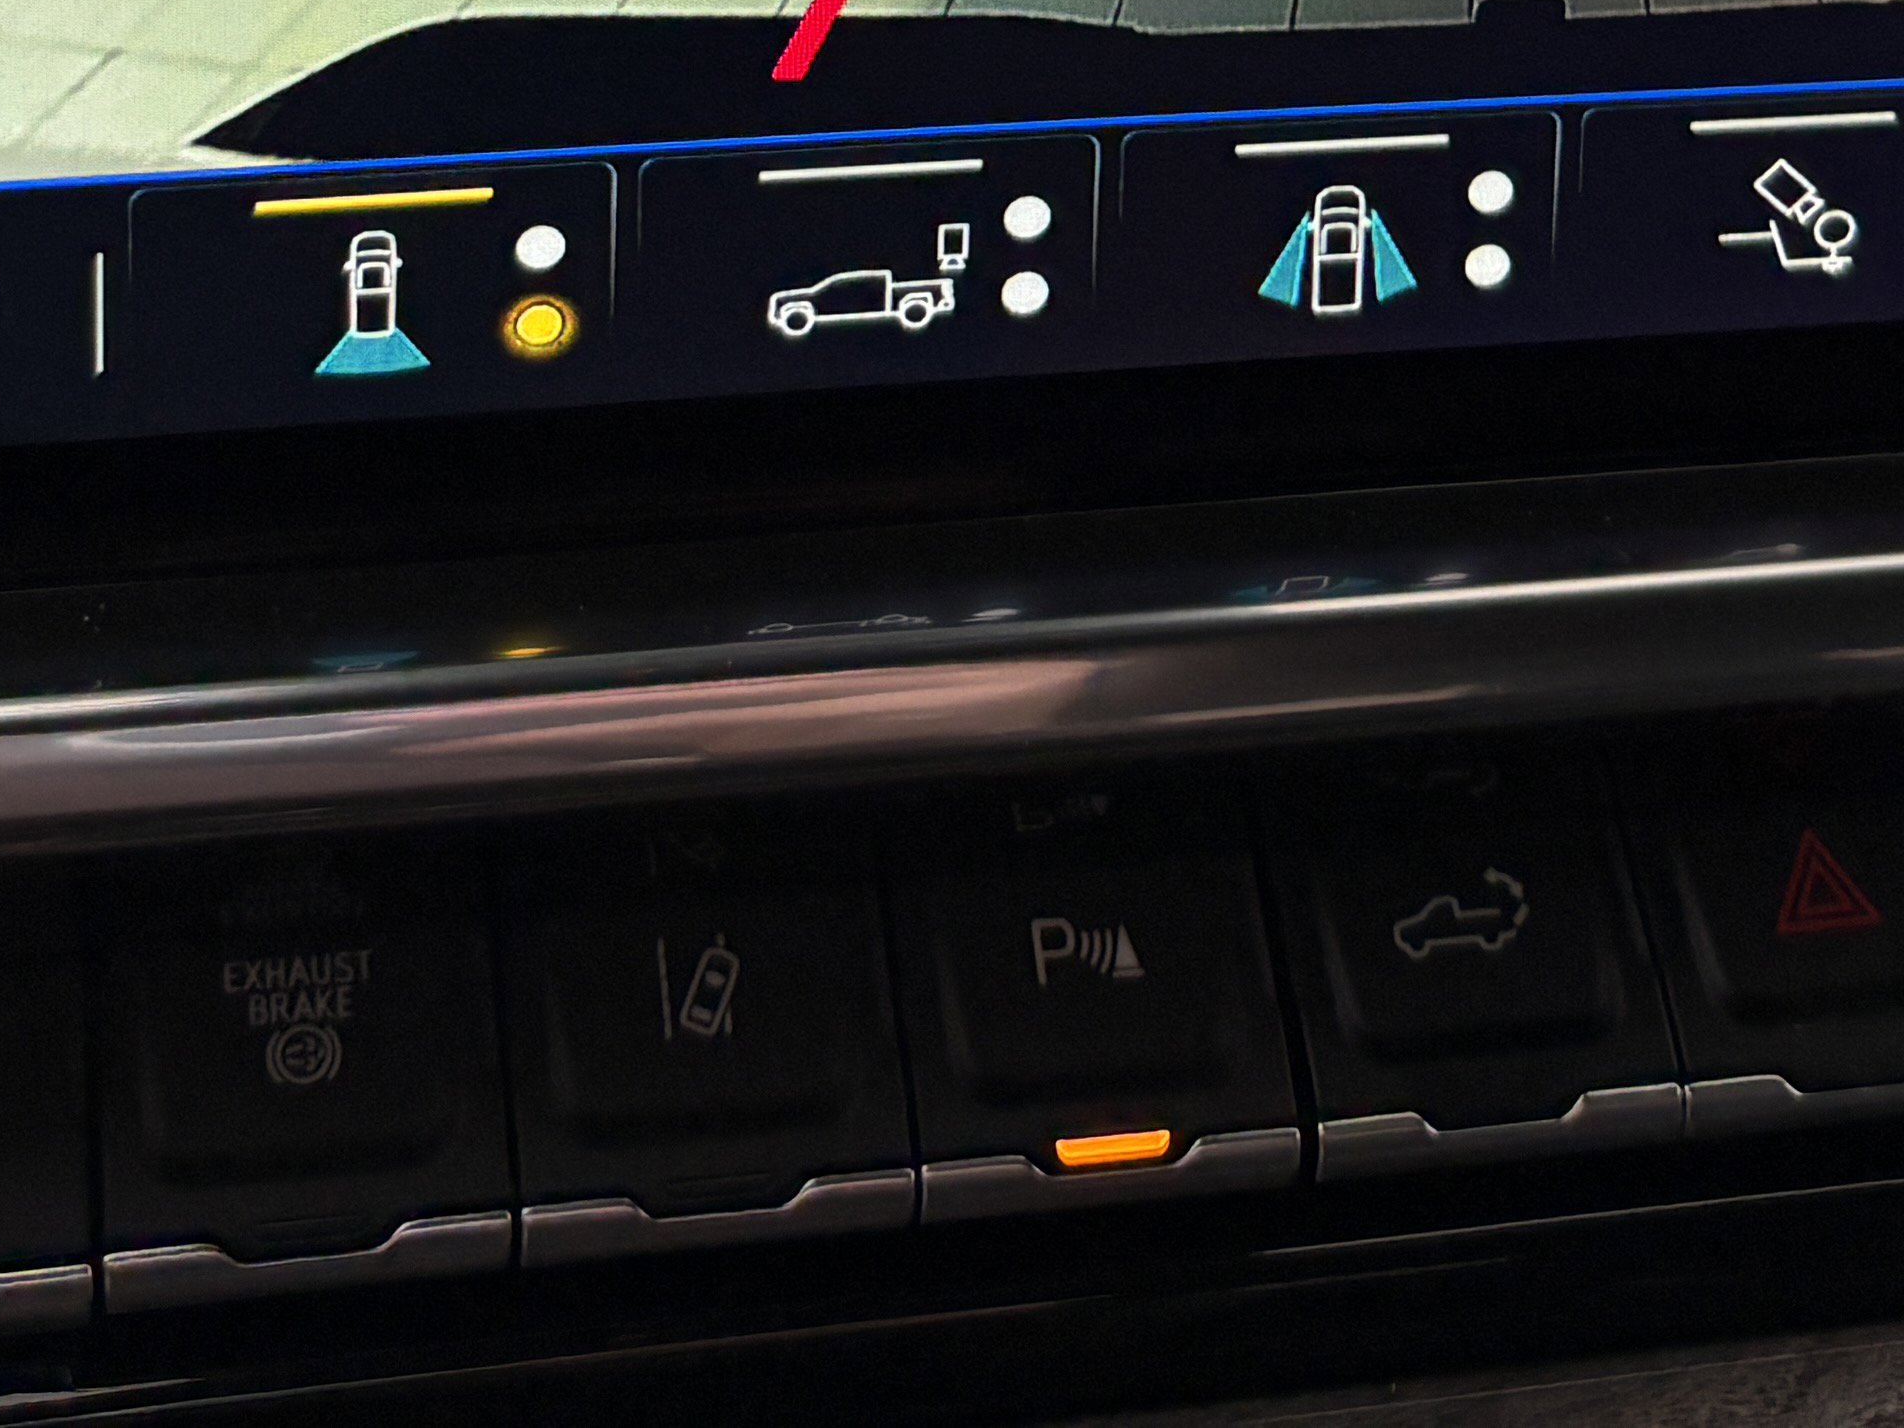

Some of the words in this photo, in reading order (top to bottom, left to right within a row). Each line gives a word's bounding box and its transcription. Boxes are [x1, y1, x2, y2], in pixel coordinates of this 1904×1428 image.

[223, 948, 373, 993] EXHAUST
[1030, 917, 1076, 986] P
[248, 985, 353, 1025] BRAKE
